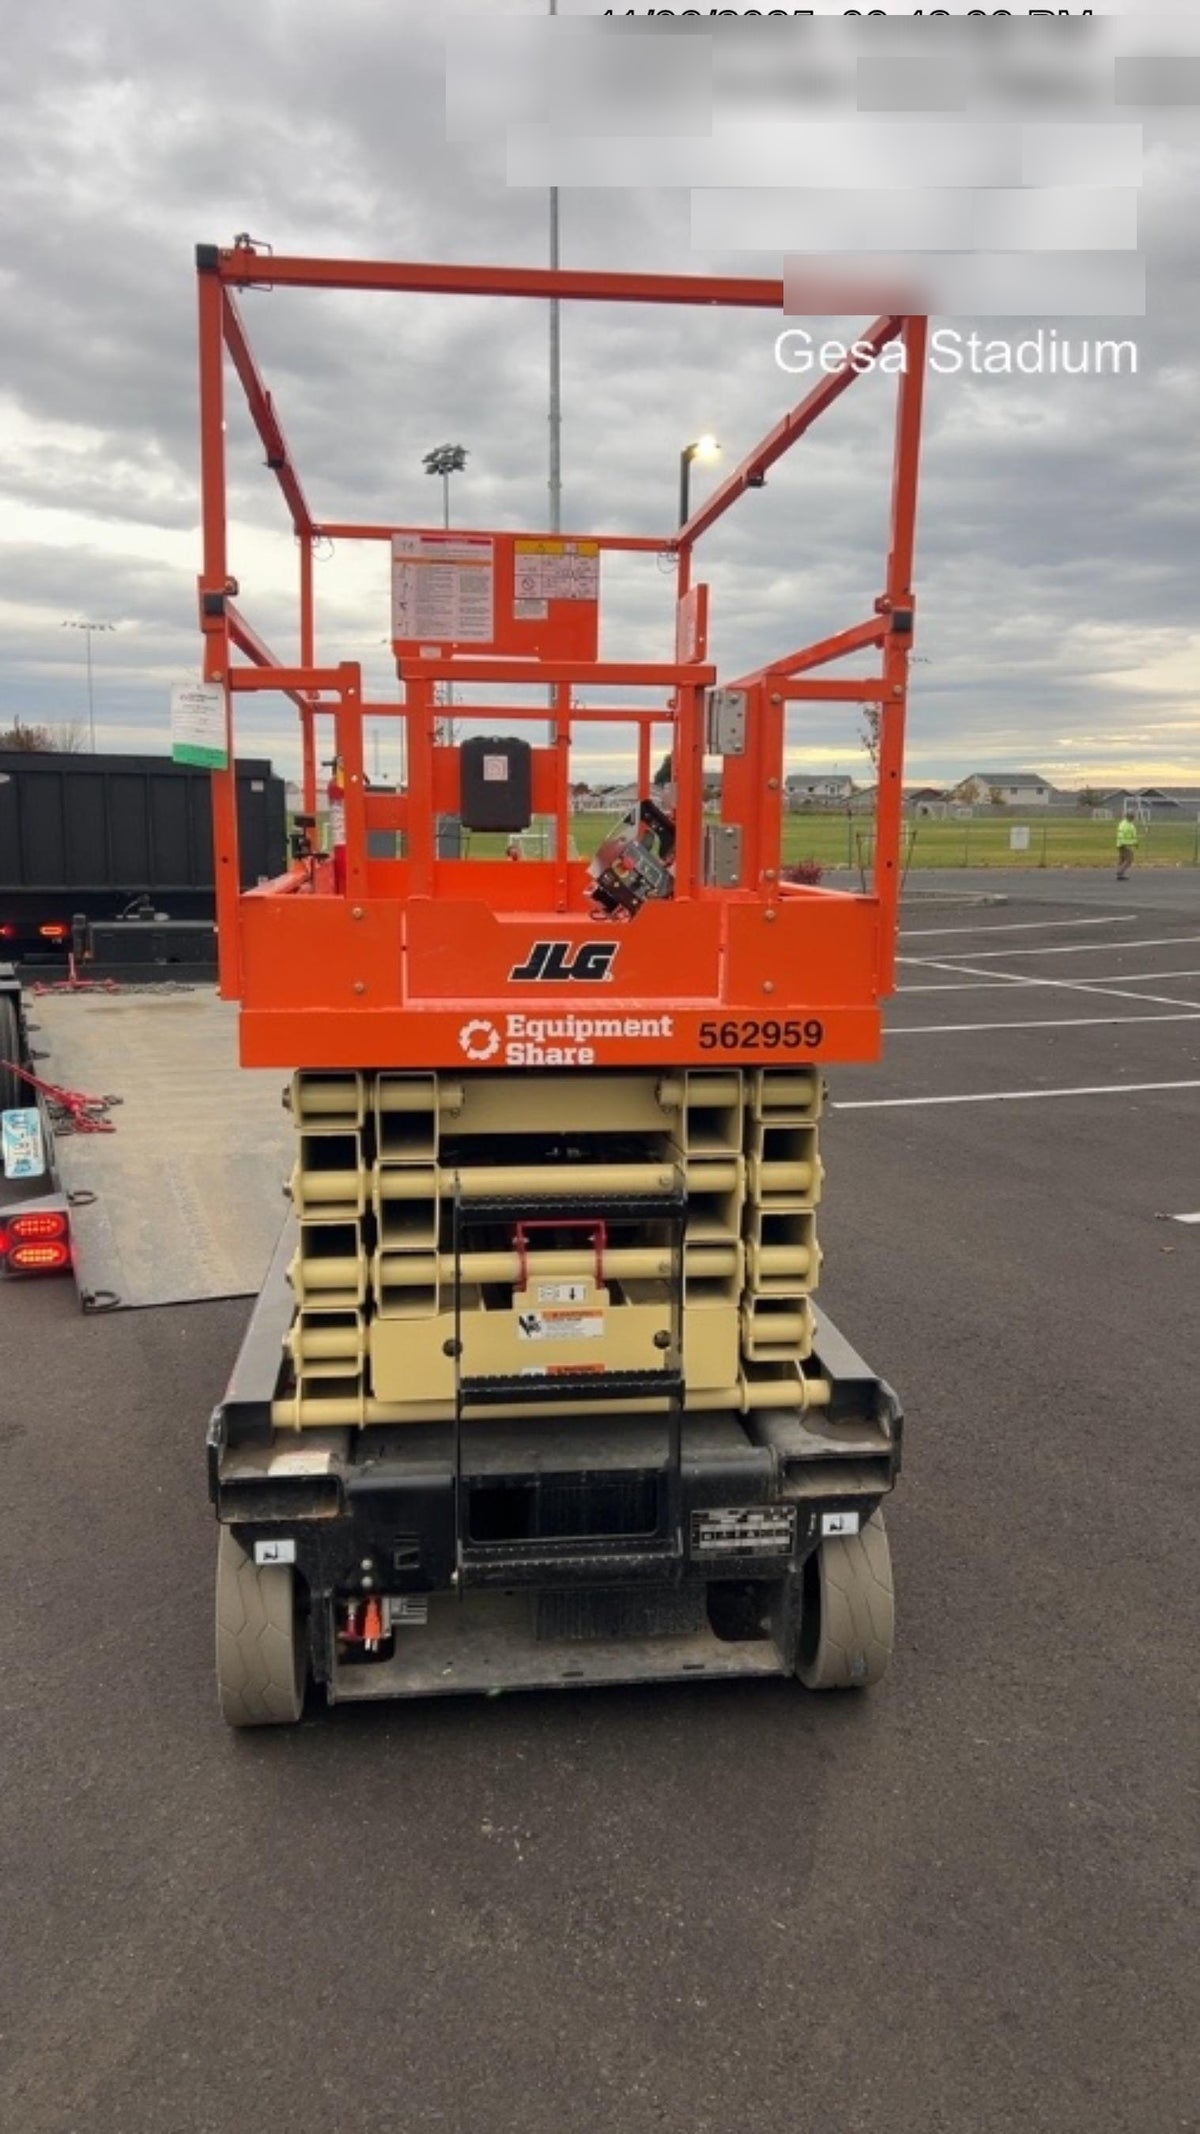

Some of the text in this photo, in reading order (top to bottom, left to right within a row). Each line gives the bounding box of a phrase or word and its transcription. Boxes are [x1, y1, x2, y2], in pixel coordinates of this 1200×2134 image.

[508, 940, 620, 982] JLG
[506, 1014, 673, 1040] Equipment
[699, 1020, 824, 1049] 562959
[506, 1042, 595, 1066] Share
